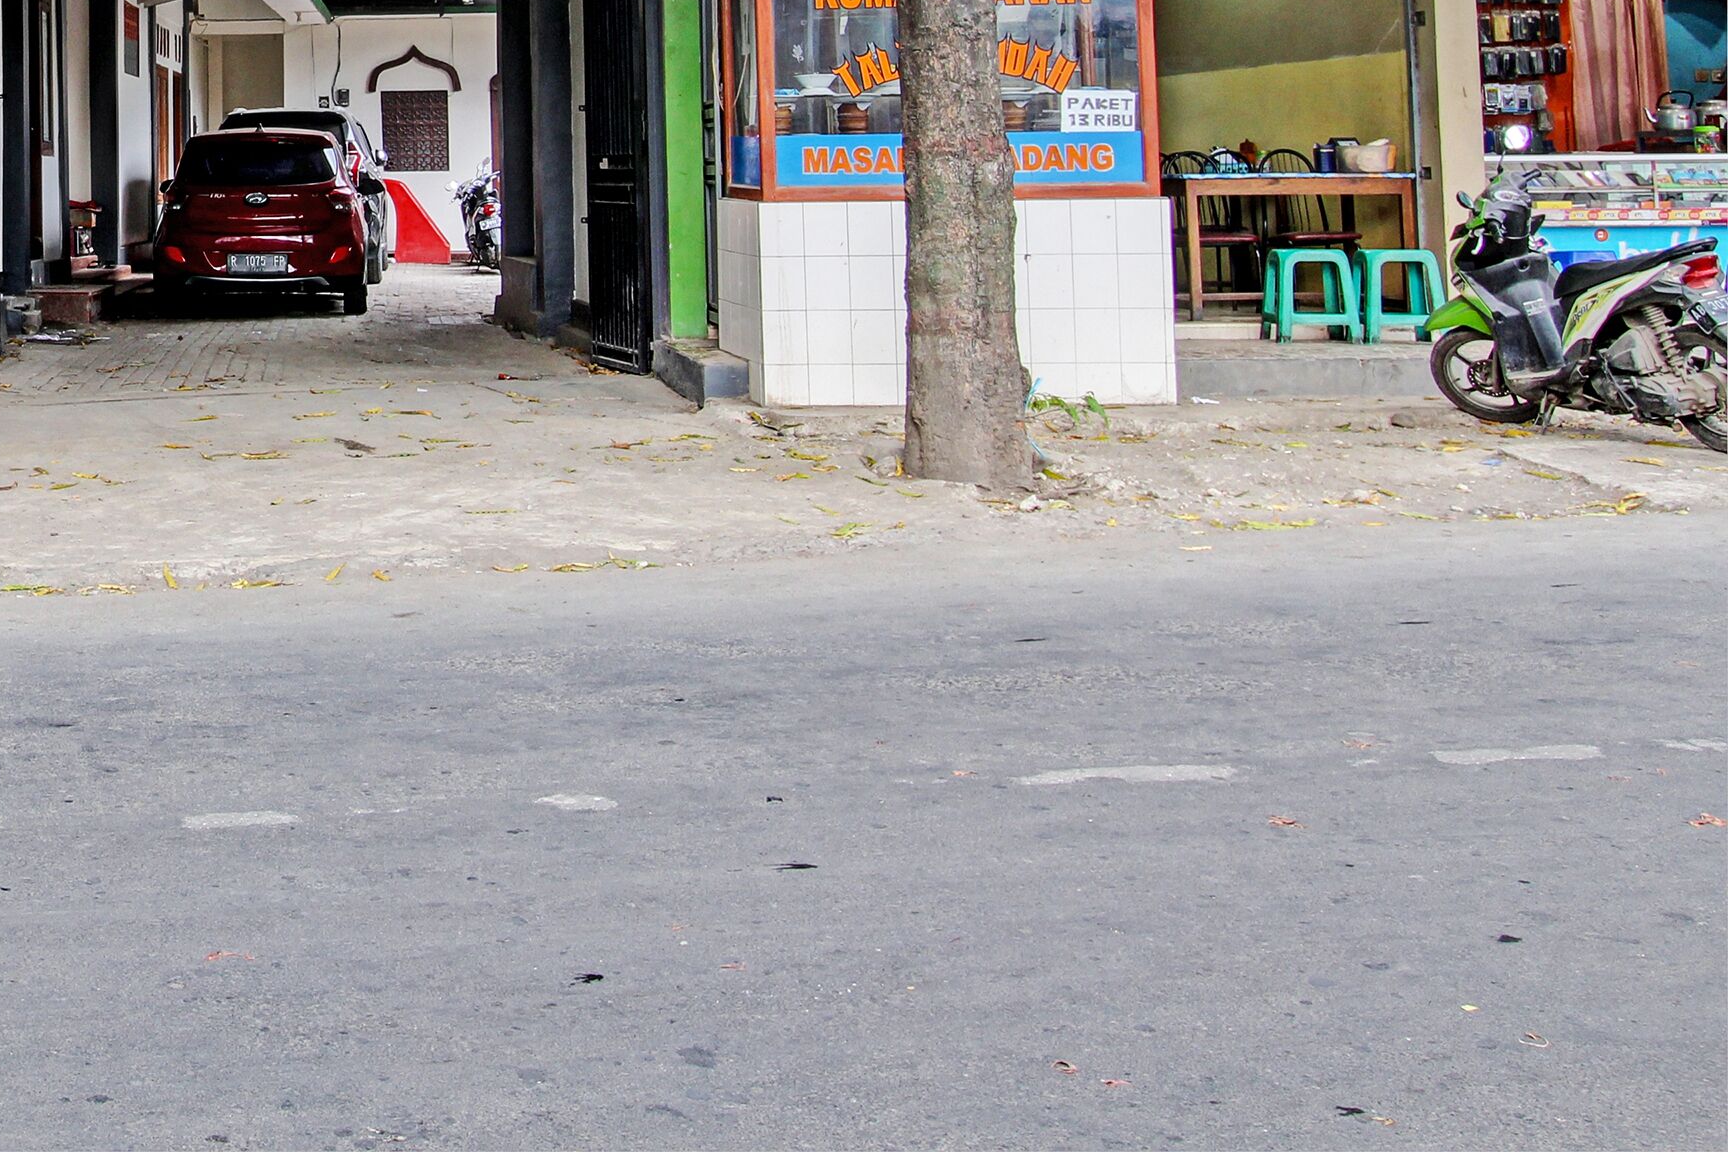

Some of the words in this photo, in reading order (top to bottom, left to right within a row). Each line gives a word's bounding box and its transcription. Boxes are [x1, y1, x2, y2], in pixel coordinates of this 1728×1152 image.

[829, 36, 902, 99] TAL
[1066, 97, 1134, 110] PAKET
[1068, 113, 1090, 126] 13
[230, 255, 238, 267] R
[245, 255, 266, 267] 1075
